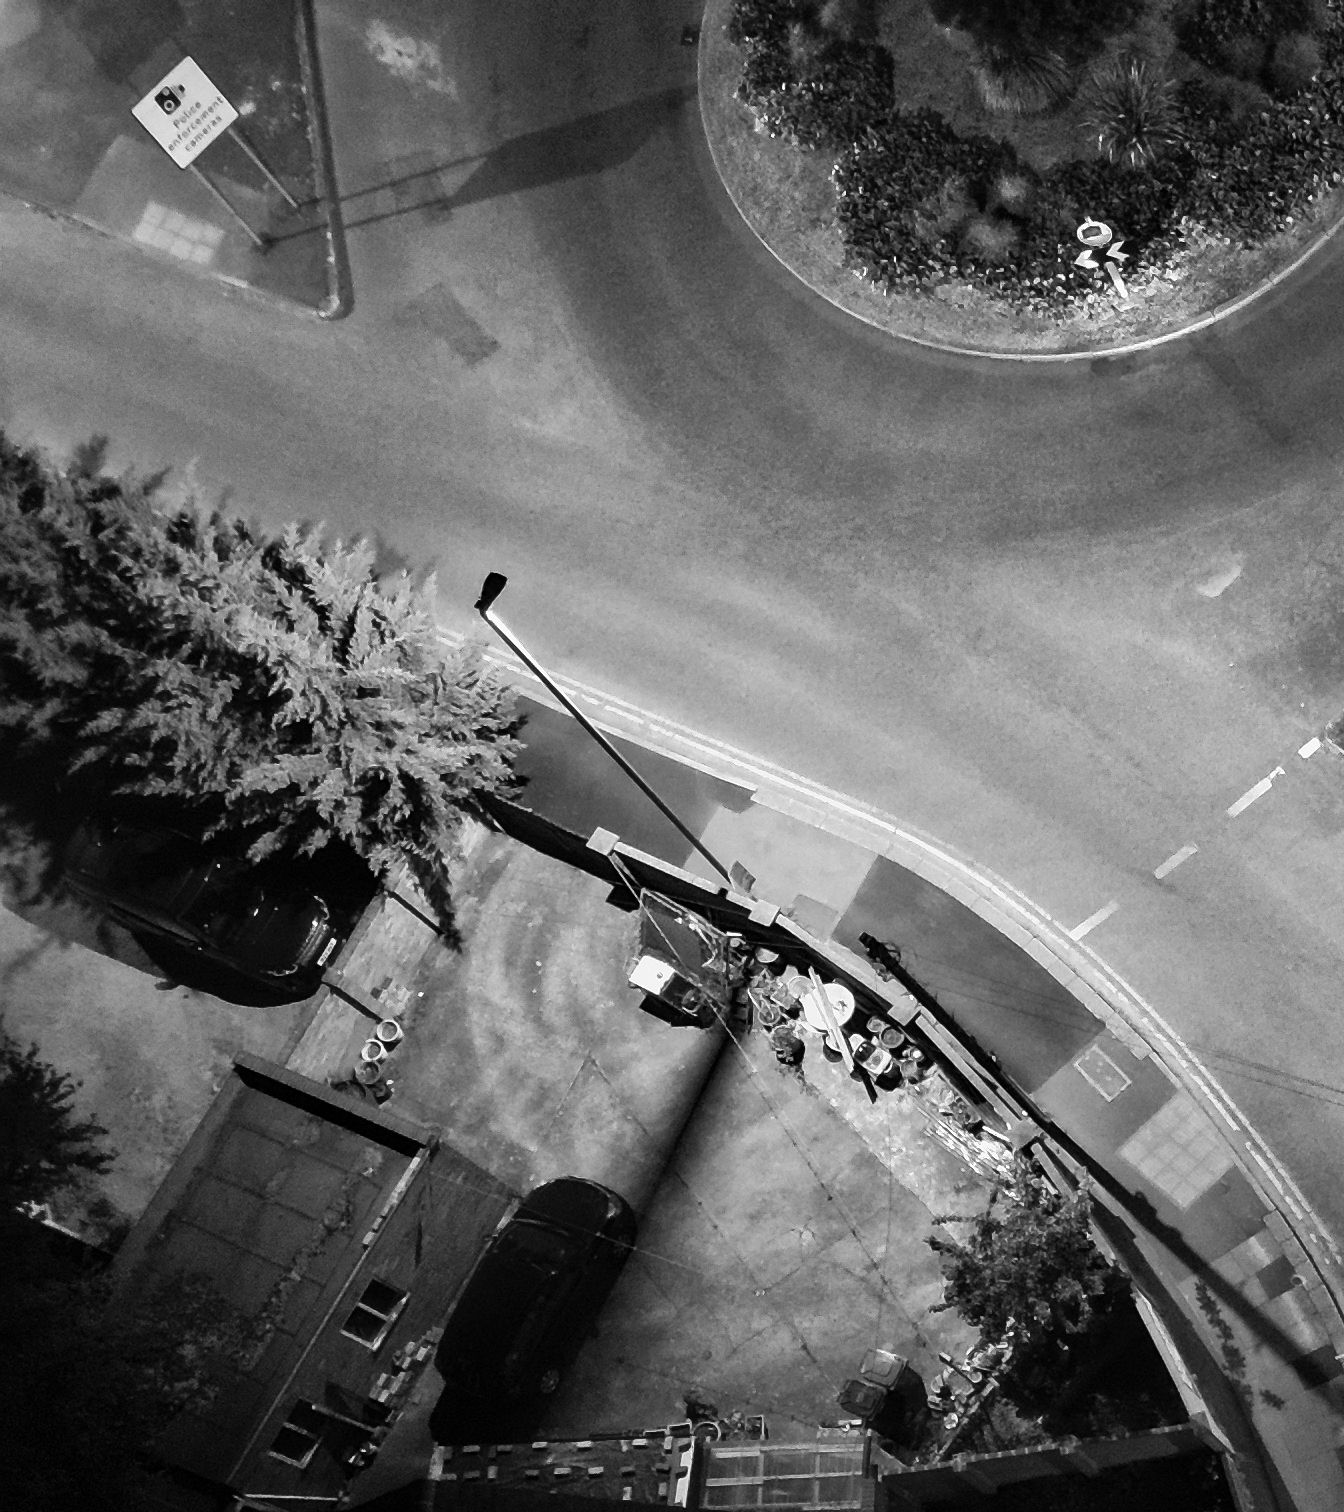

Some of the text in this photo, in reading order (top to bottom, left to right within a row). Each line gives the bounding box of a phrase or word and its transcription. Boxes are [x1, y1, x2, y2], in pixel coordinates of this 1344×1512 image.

[168, 95, 224, 152] enforcement
[173, 100, 202, 129] Police
[184, 115, 223, 152] cameras
